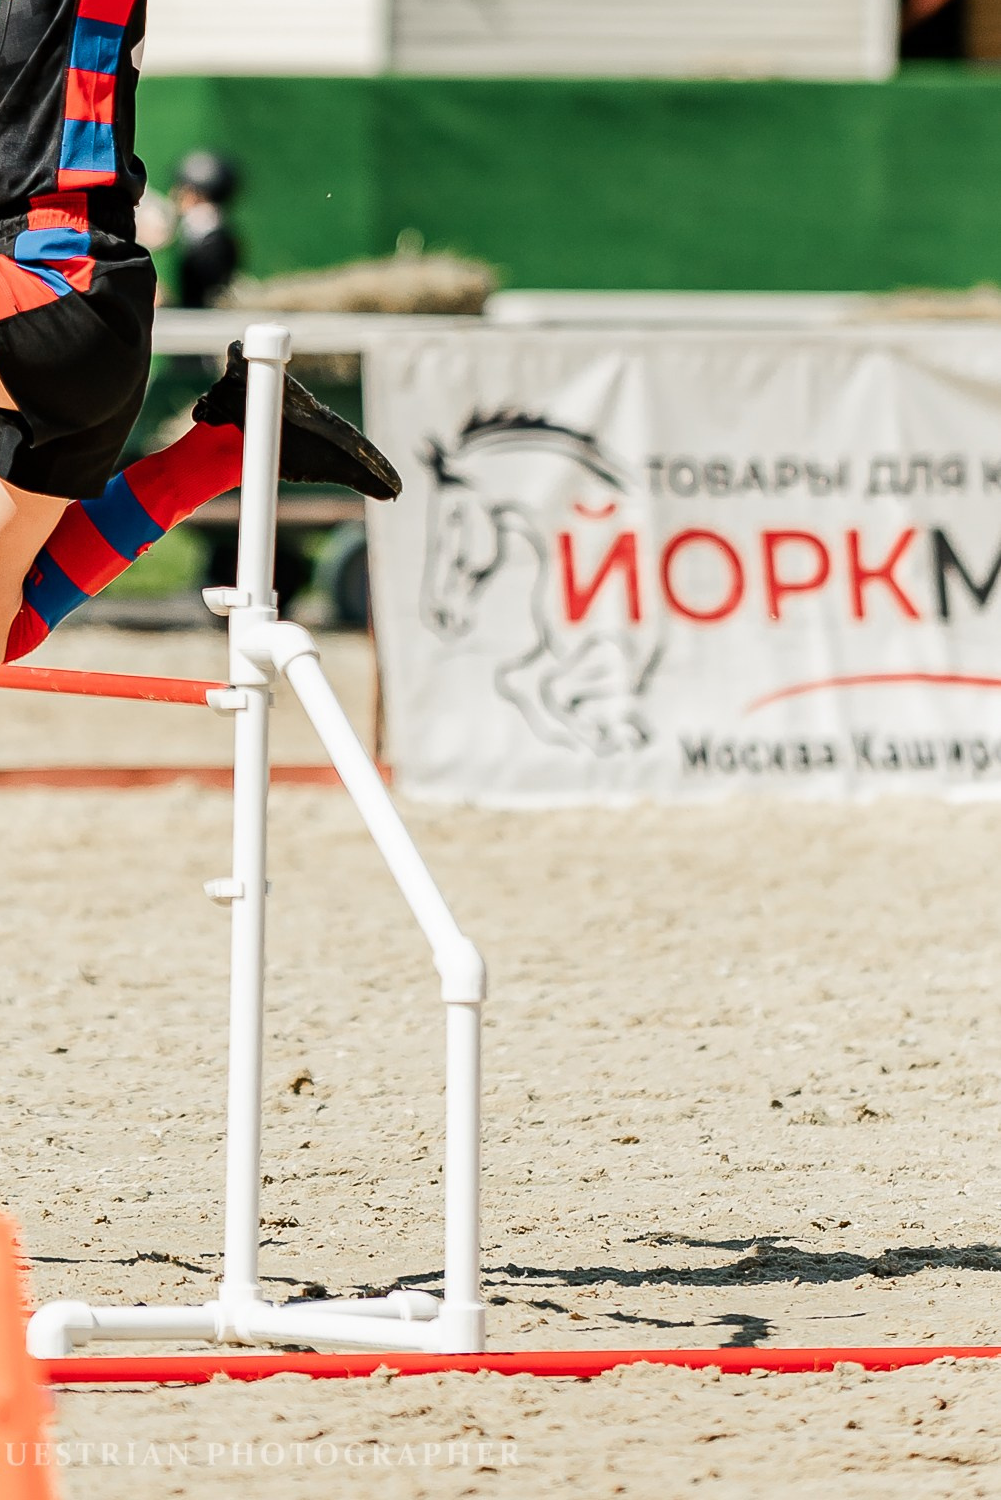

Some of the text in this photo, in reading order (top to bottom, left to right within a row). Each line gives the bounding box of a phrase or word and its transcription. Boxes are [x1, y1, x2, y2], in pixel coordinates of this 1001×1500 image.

[646, 455, 849, 498] ТОВАРЫ
[865, 455, 965, 502] ДЛЯ
[680, 732, 835, 775] Москва
